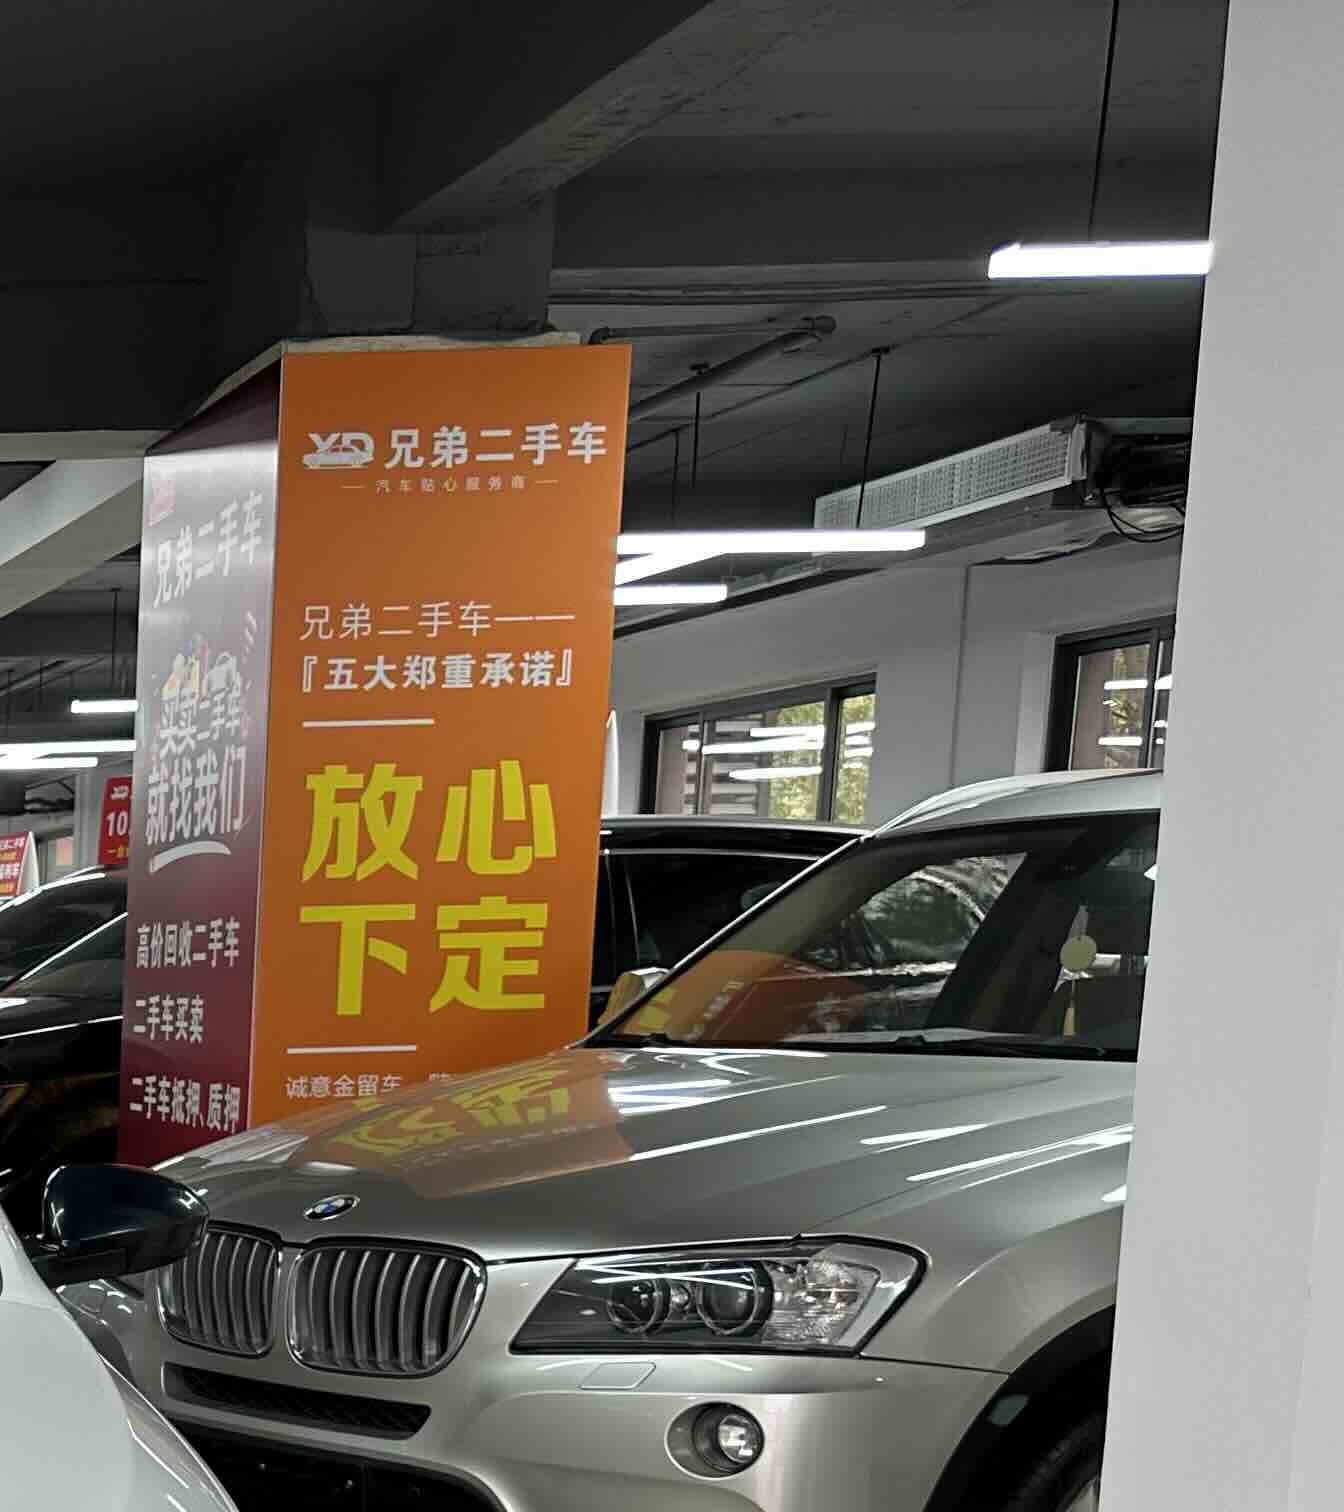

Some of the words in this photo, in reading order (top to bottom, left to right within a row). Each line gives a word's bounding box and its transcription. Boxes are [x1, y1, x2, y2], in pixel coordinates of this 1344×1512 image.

[385, 422, 608, 469] 兄弟二手车
[153, 490, 263, 608] 兄弟二手车
[302, 648, 574, 693] 『五大郑重承诺』
[144, 745, 248, 846] 就找我们
[302, 760, 557, 882] 放心
[135, 916, 241, 970] 高价回收二手车
[299, 895, 549, 1017] 下定
[133, 993, 205, 1044] 二手车买卖
[286, 1074, 402, 1098] 诚意金留车
